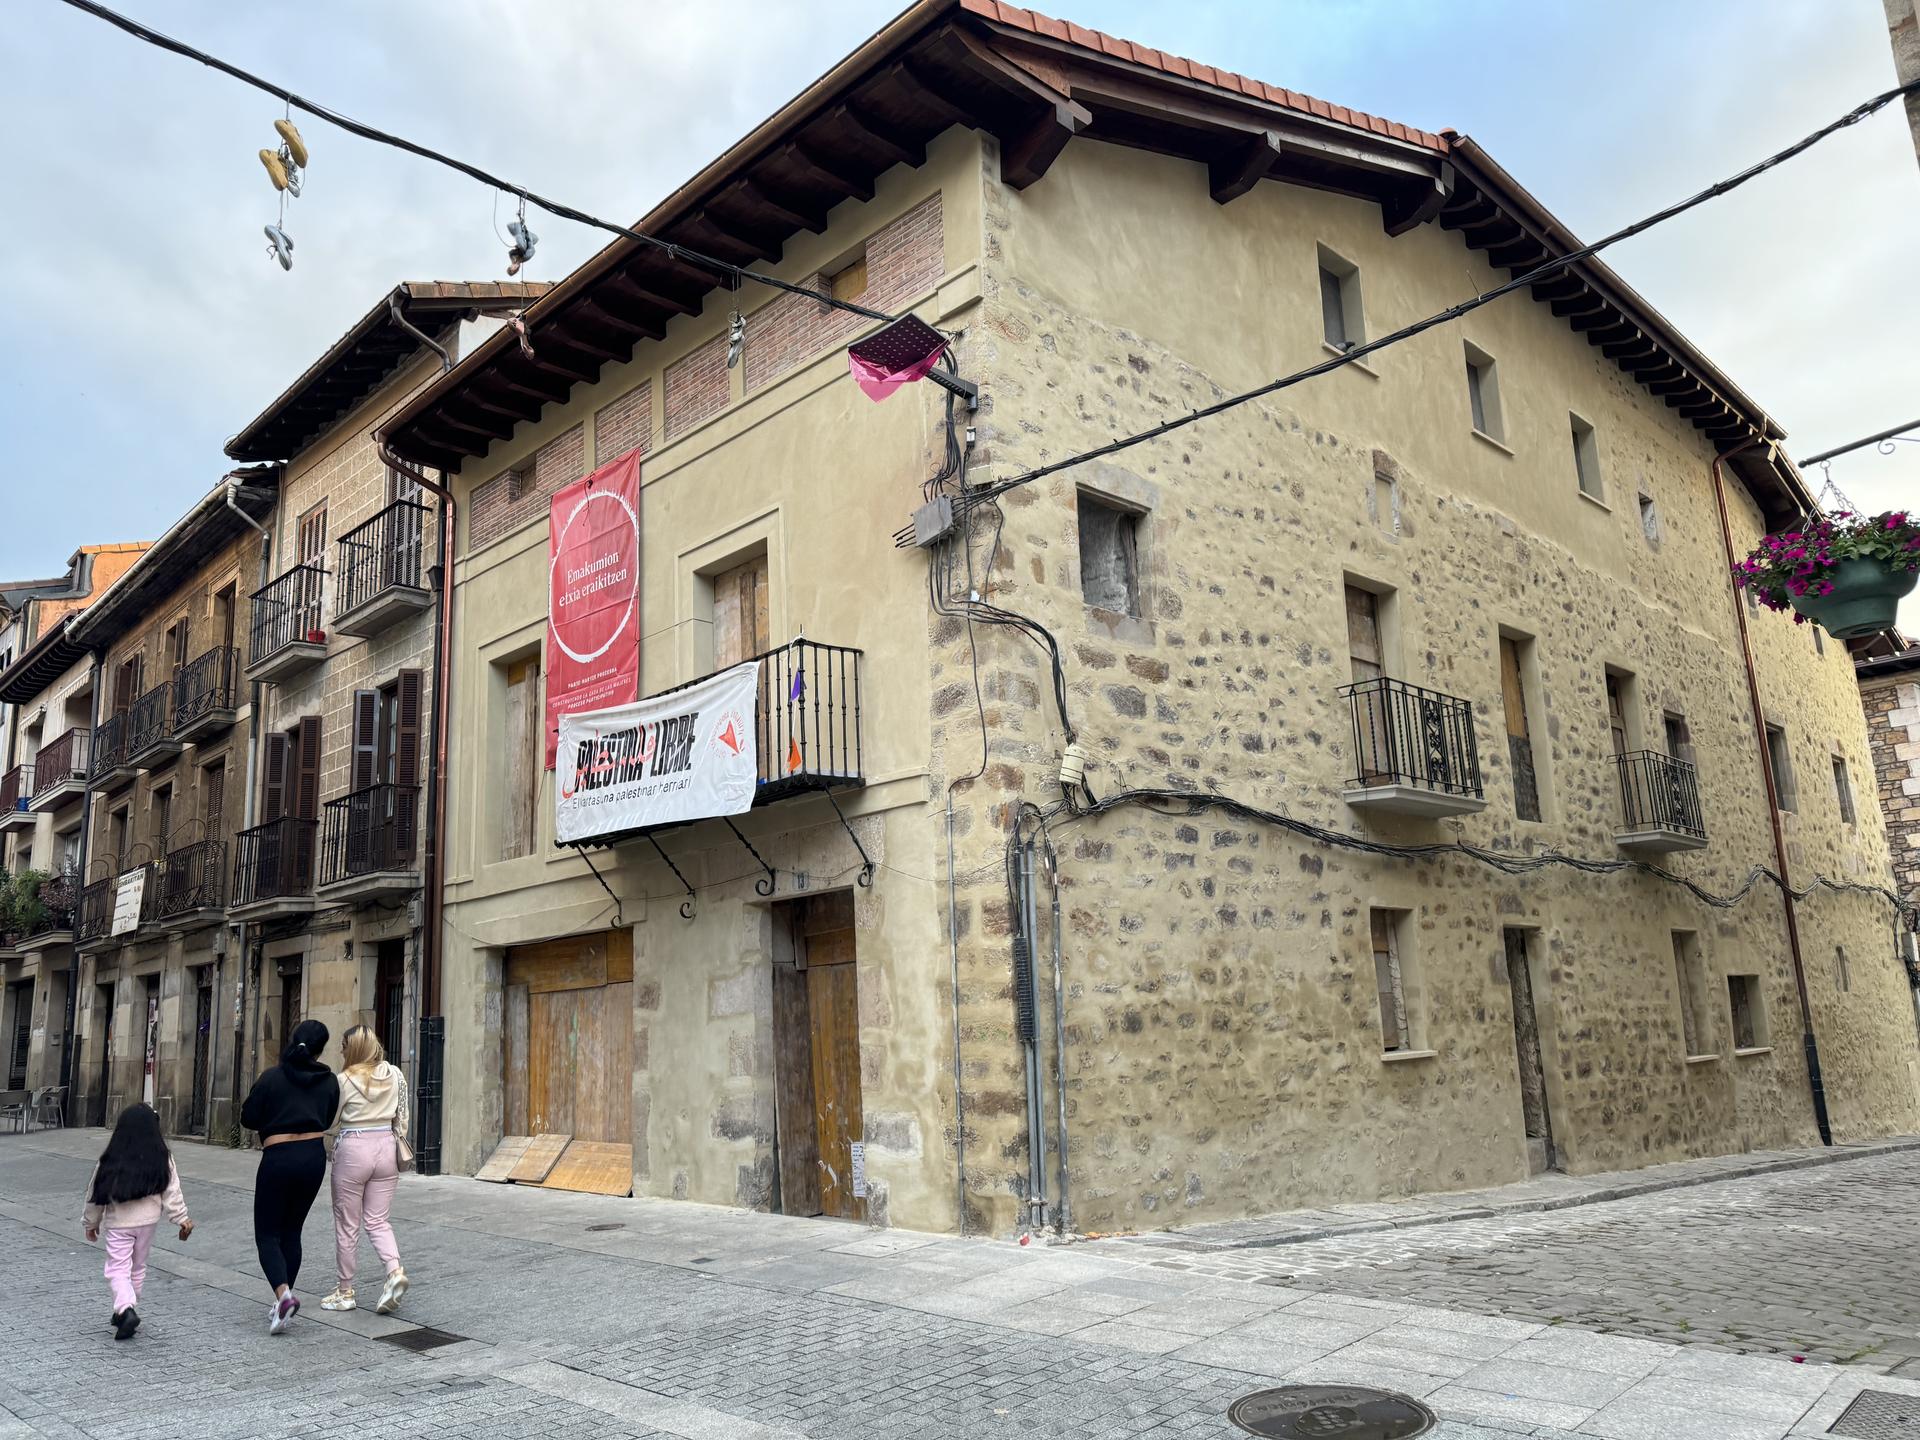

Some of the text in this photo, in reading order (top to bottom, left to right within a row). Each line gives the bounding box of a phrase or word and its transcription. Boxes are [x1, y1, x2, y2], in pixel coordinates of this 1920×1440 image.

[567, 552, 619, 585] Emakumion
[559, 568, 627, 607] etxia eraikitzen
[574, 725, 646, 793] PALESTINA
[650, 712, 699, 777] LIBRE
[616, 784, 656, 804] palestinar
